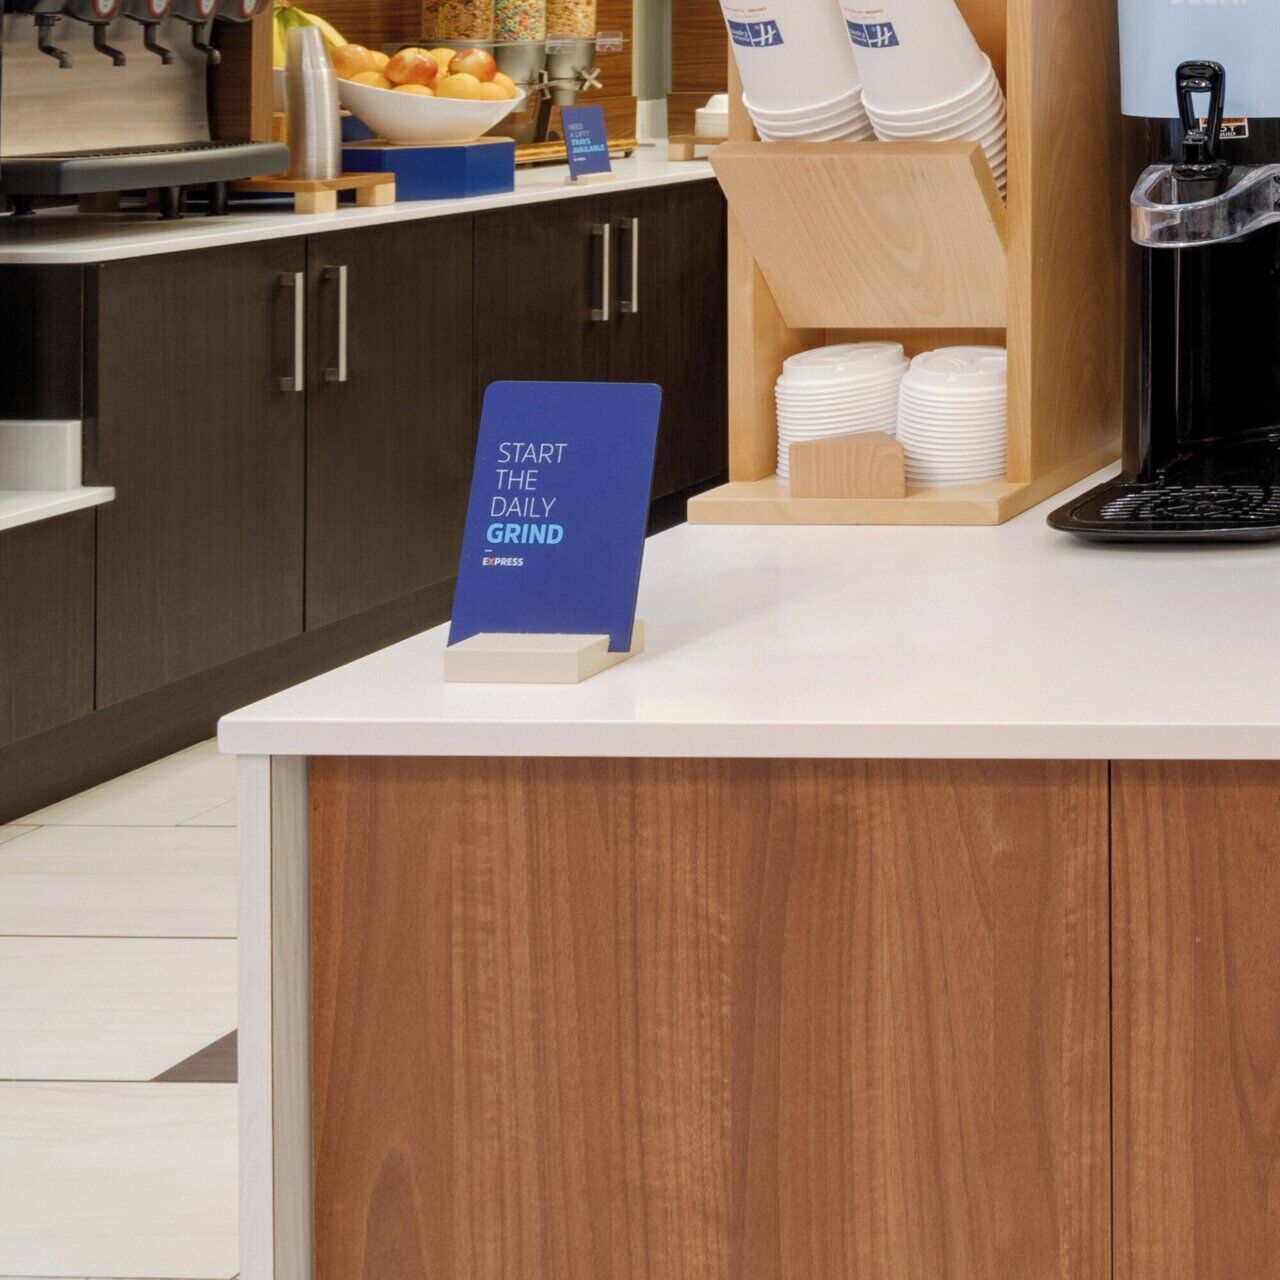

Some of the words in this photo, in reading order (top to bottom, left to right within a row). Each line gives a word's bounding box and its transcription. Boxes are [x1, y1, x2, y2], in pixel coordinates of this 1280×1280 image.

[496, 441, 568, 464] START
[495, 469, 539, 491] THE
[490, 496, 557, 518] DAILY
[486, 522, 564, 545] GRIND
[482, 556, 524, 567] EXPRESS
